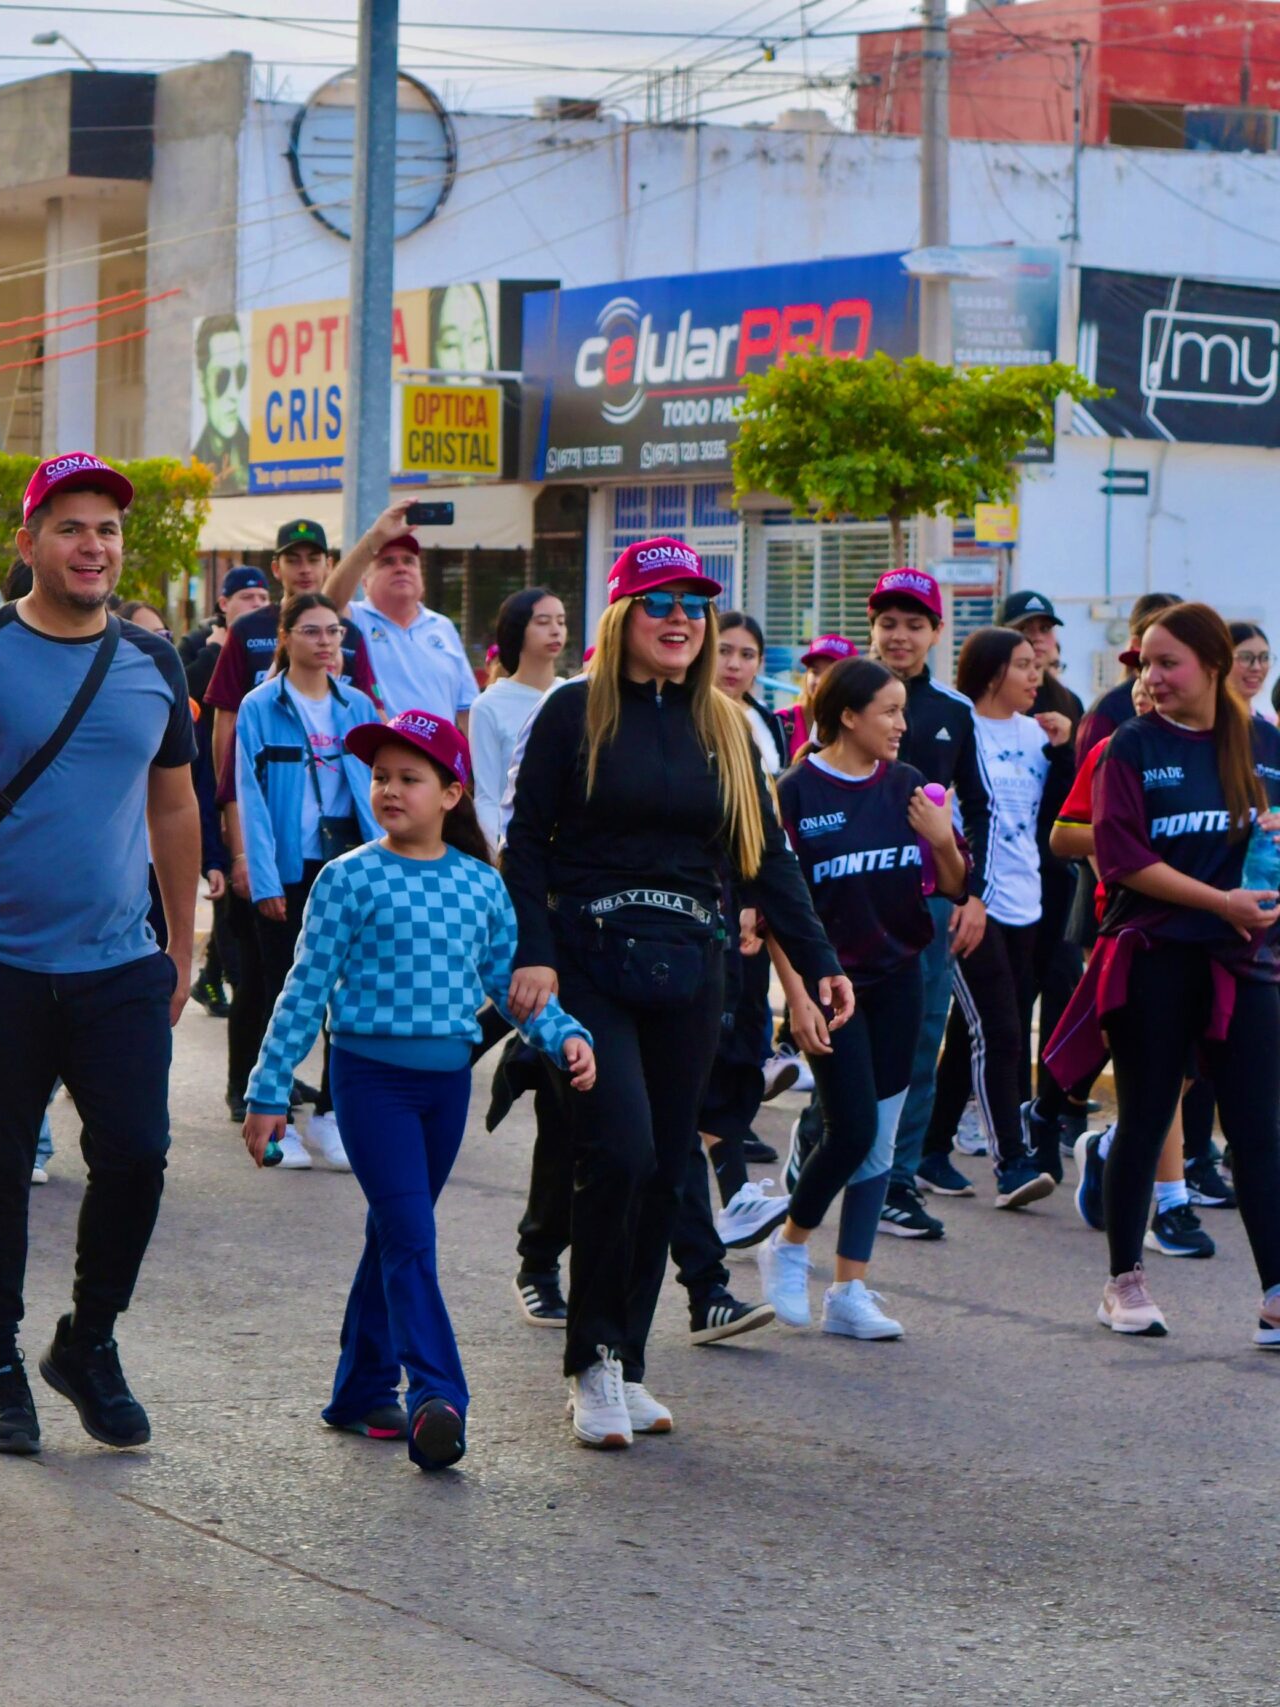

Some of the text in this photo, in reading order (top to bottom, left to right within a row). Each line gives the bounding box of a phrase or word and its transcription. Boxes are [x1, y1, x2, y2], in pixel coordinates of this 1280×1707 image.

[267, 308, 410, 378] OPTIA
[266, 385, 342, 443] CRIS
[414, 392, 488, 428] OPTICA
[662, 400, 711, 427] TODO
[408, 430, 495, 467] CRISTAL
[799, 811, 847, 832] ONADE
[1151, 810, 1230, 839] PONTE
[813, 847, 898, 884] PONTE
[591, 896, 624, 914] MBA
[626, 891, 639, 902] Y
[644, 891, 683, 910] LOLA
